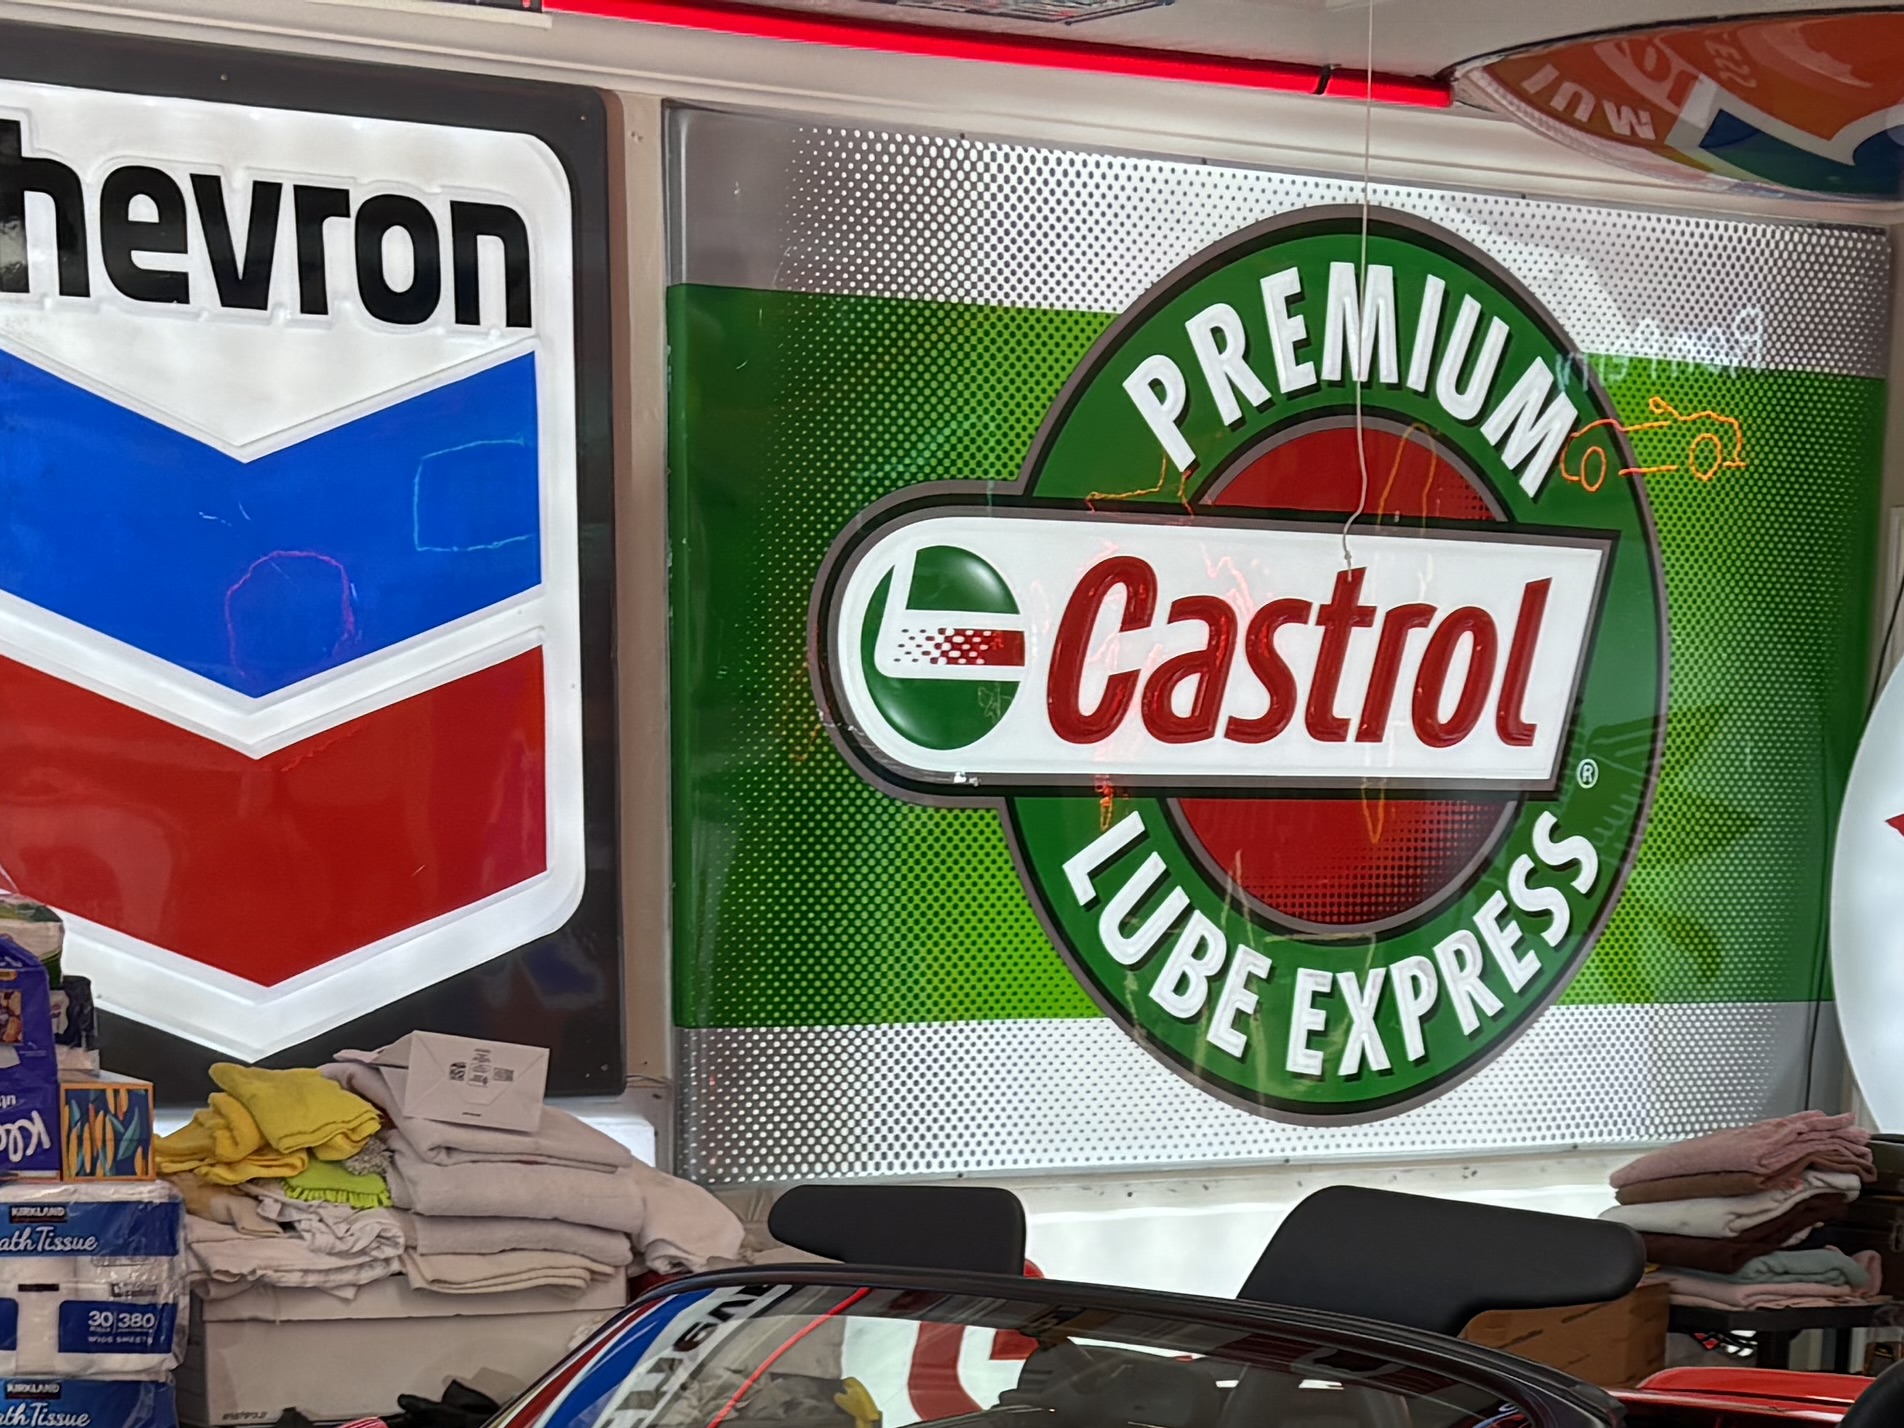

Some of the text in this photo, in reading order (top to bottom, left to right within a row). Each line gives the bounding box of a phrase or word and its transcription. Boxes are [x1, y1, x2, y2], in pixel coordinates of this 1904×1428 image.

[1124, 261, 1582, 500] PREMIUM
[1047, 554, 1553, 750] Castrol
[1064, 811, 1599, 1077] LUBE EXPRESS
[11, 1207, 65, 1218] KIRKLAND
[36, 1226, 98, 1252] Tissue
[88, 1310, 155, 1329] 30 380
[7, 1384, 60, 1393] KIRKLAND
[30, 1402, 91, 1427] Tissue
